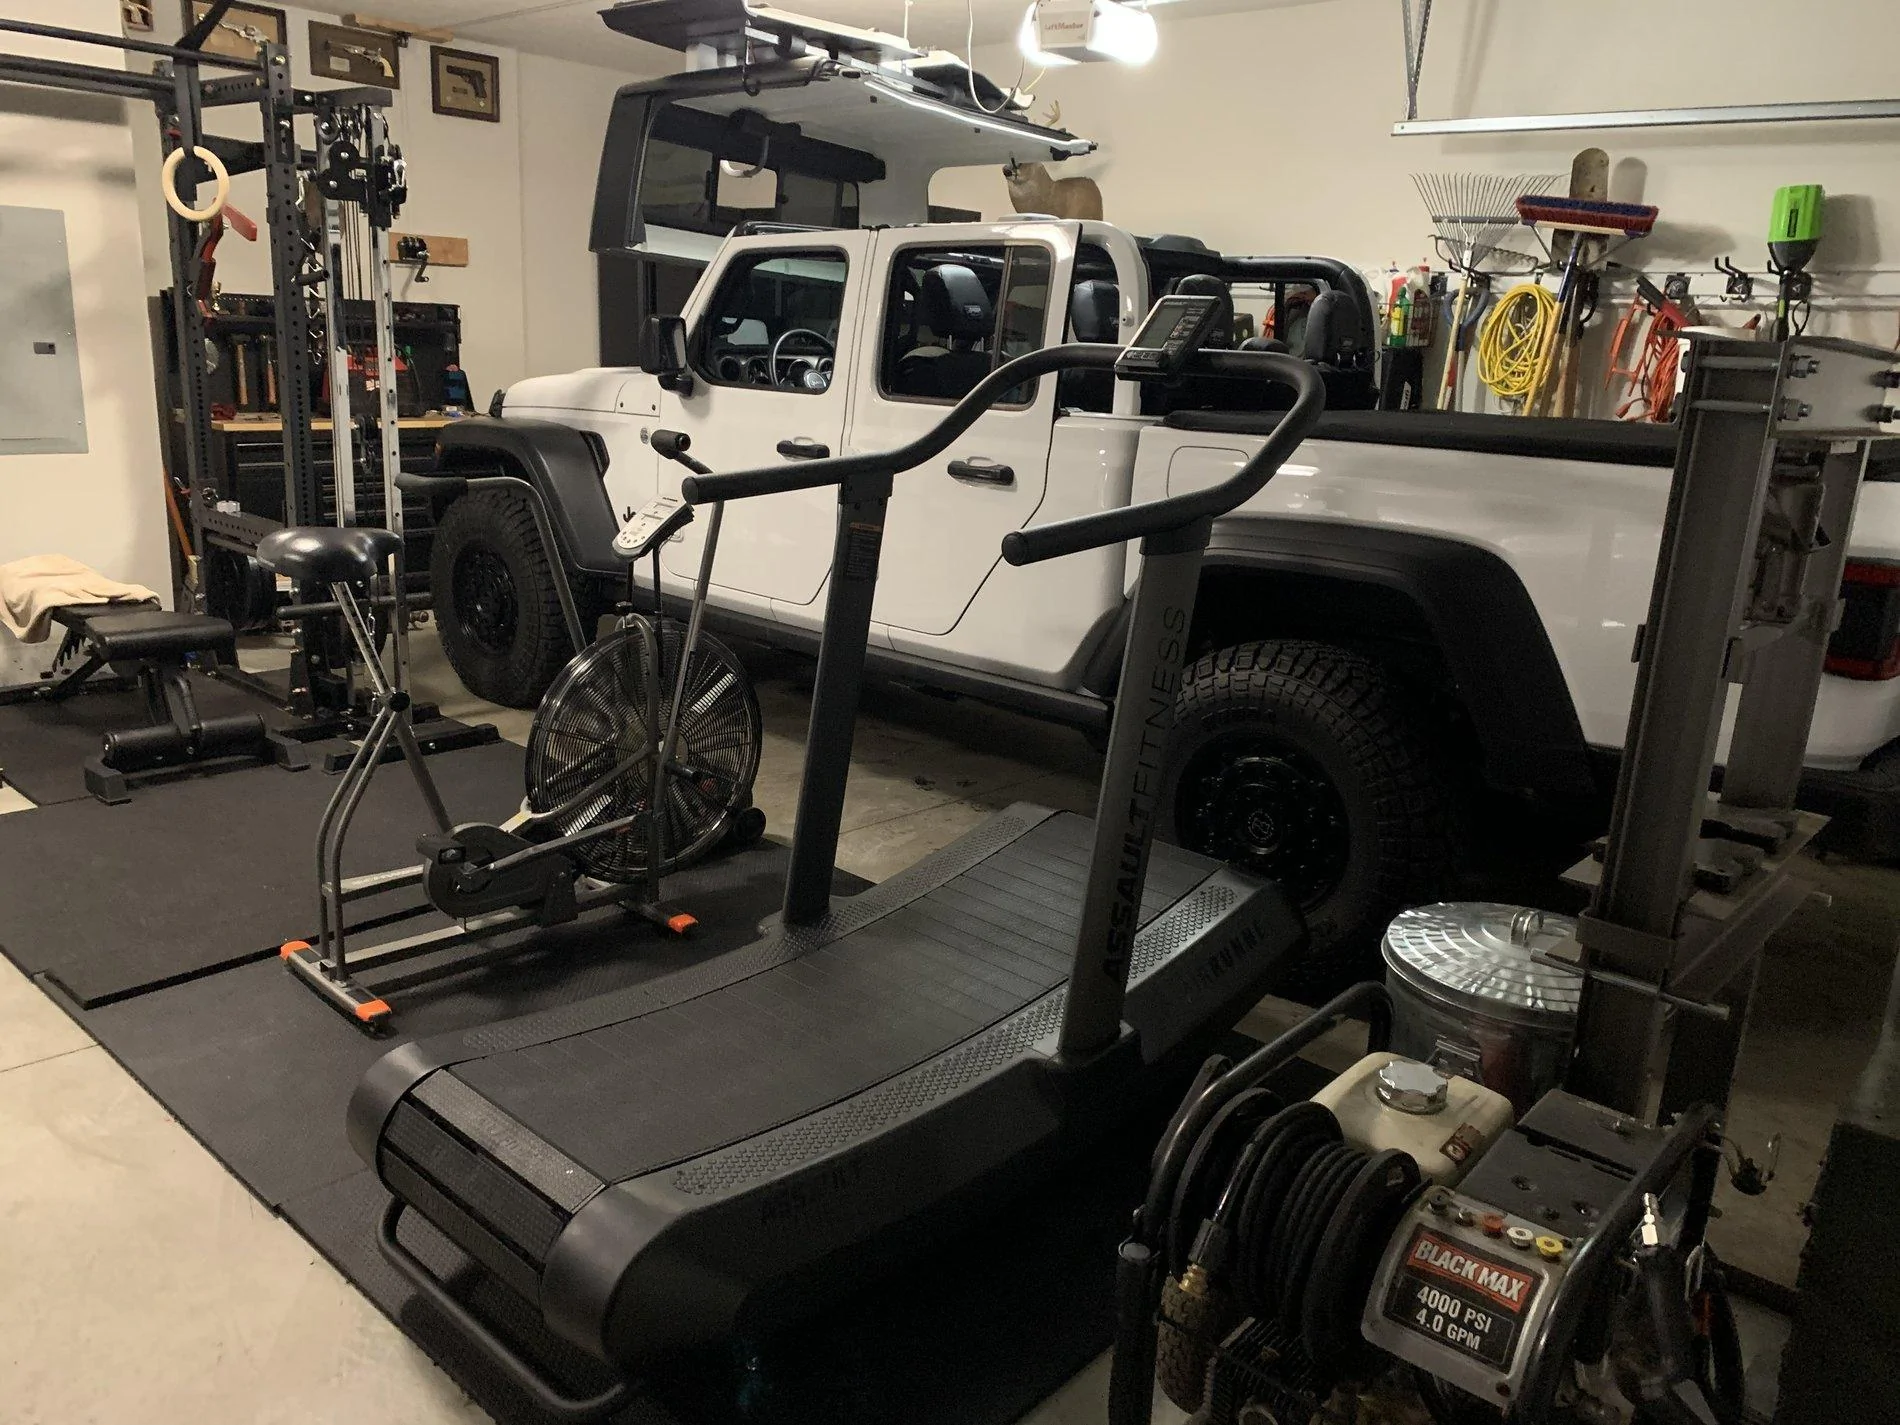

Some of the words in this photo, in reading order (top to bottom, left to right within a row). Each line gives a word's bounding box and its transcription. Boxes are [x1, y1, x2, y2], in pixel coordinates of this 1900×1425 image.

[1415, 1240, 1479, 1281] BLACK
[1476, 1266, 1525, 1302] MAX
[1416, 1308, 1444, 1332] 4.0
[1447, 1323, 1480, 1350] GPM
[1417, 1286, 1461, 1318] 4000
[1464, 1308, 1492, 1333] PSI
